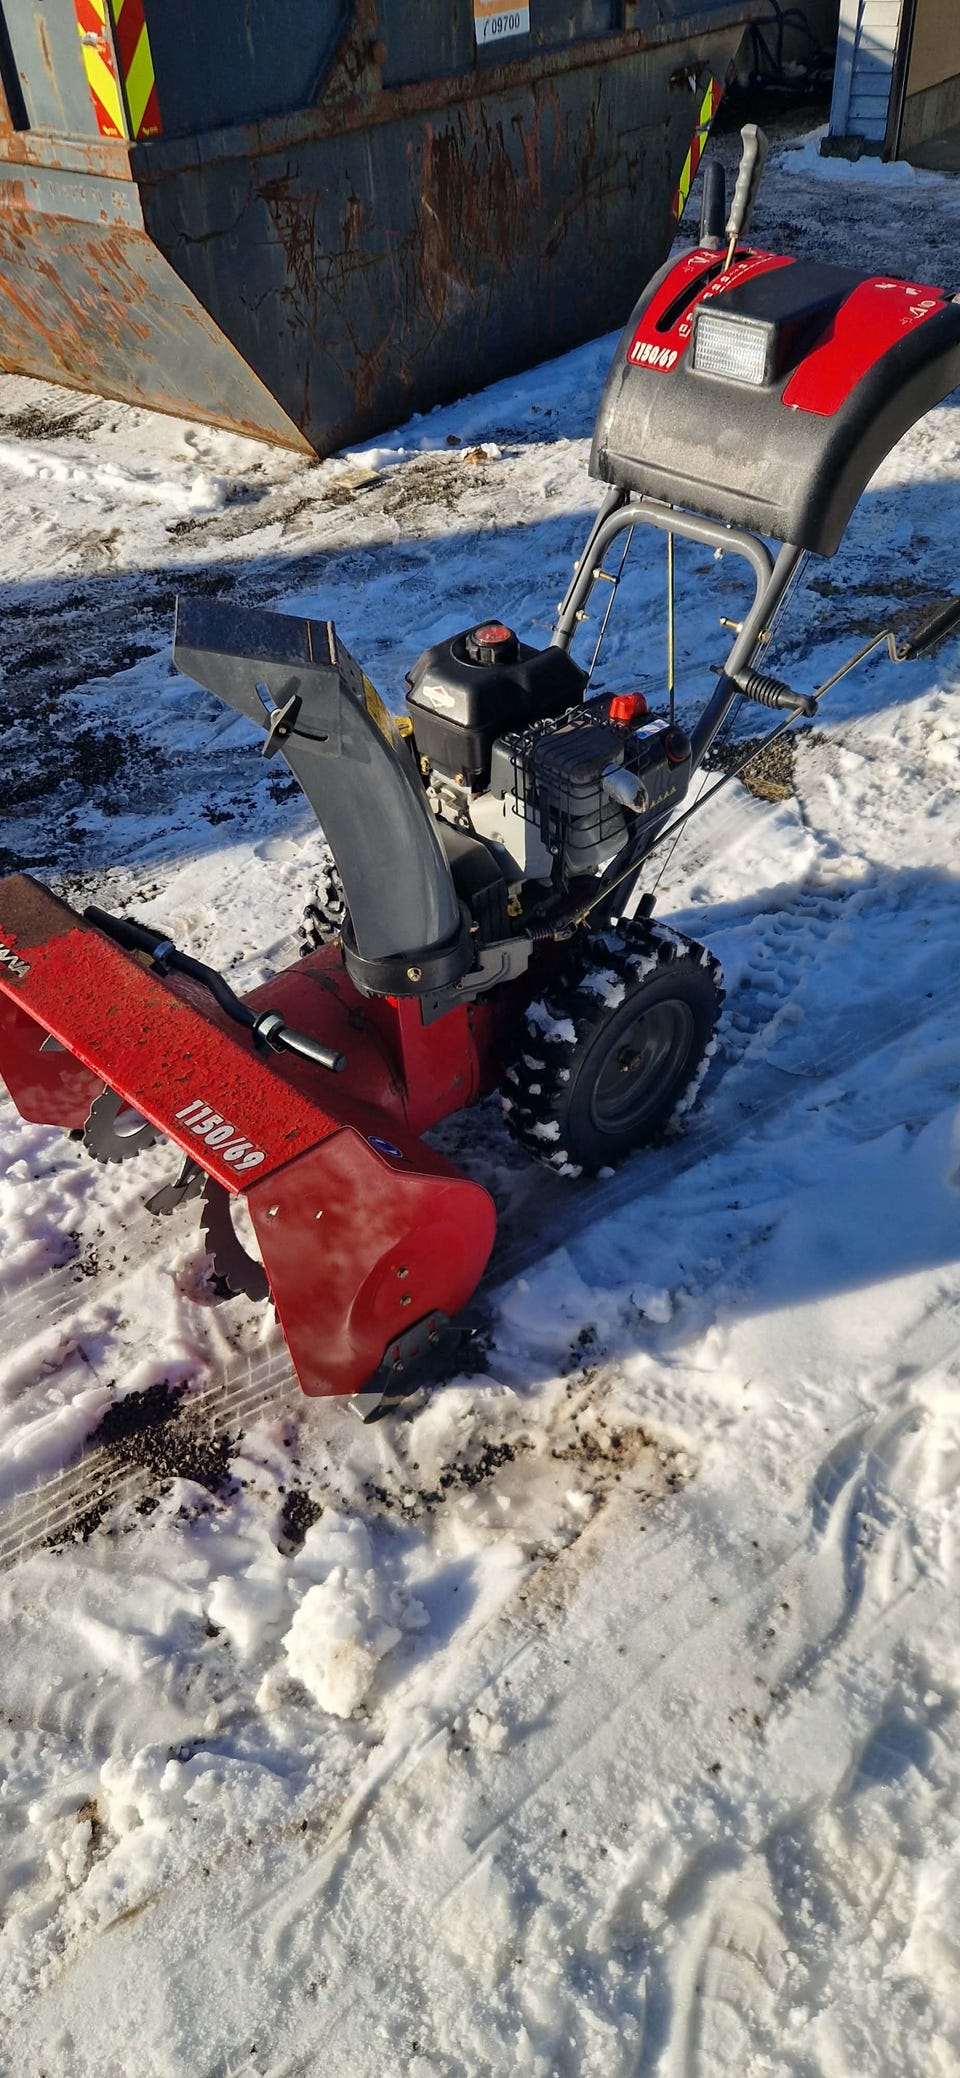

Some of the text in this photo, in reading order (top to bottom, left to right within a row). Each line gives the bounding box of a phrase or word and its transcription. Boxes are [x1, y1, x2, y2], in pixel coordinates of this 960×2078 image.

[491, 13, 520, 34] 09700
[631, 341, 678, 368] 1150/69
[175, 1099, 265, 1170] 1150/69
